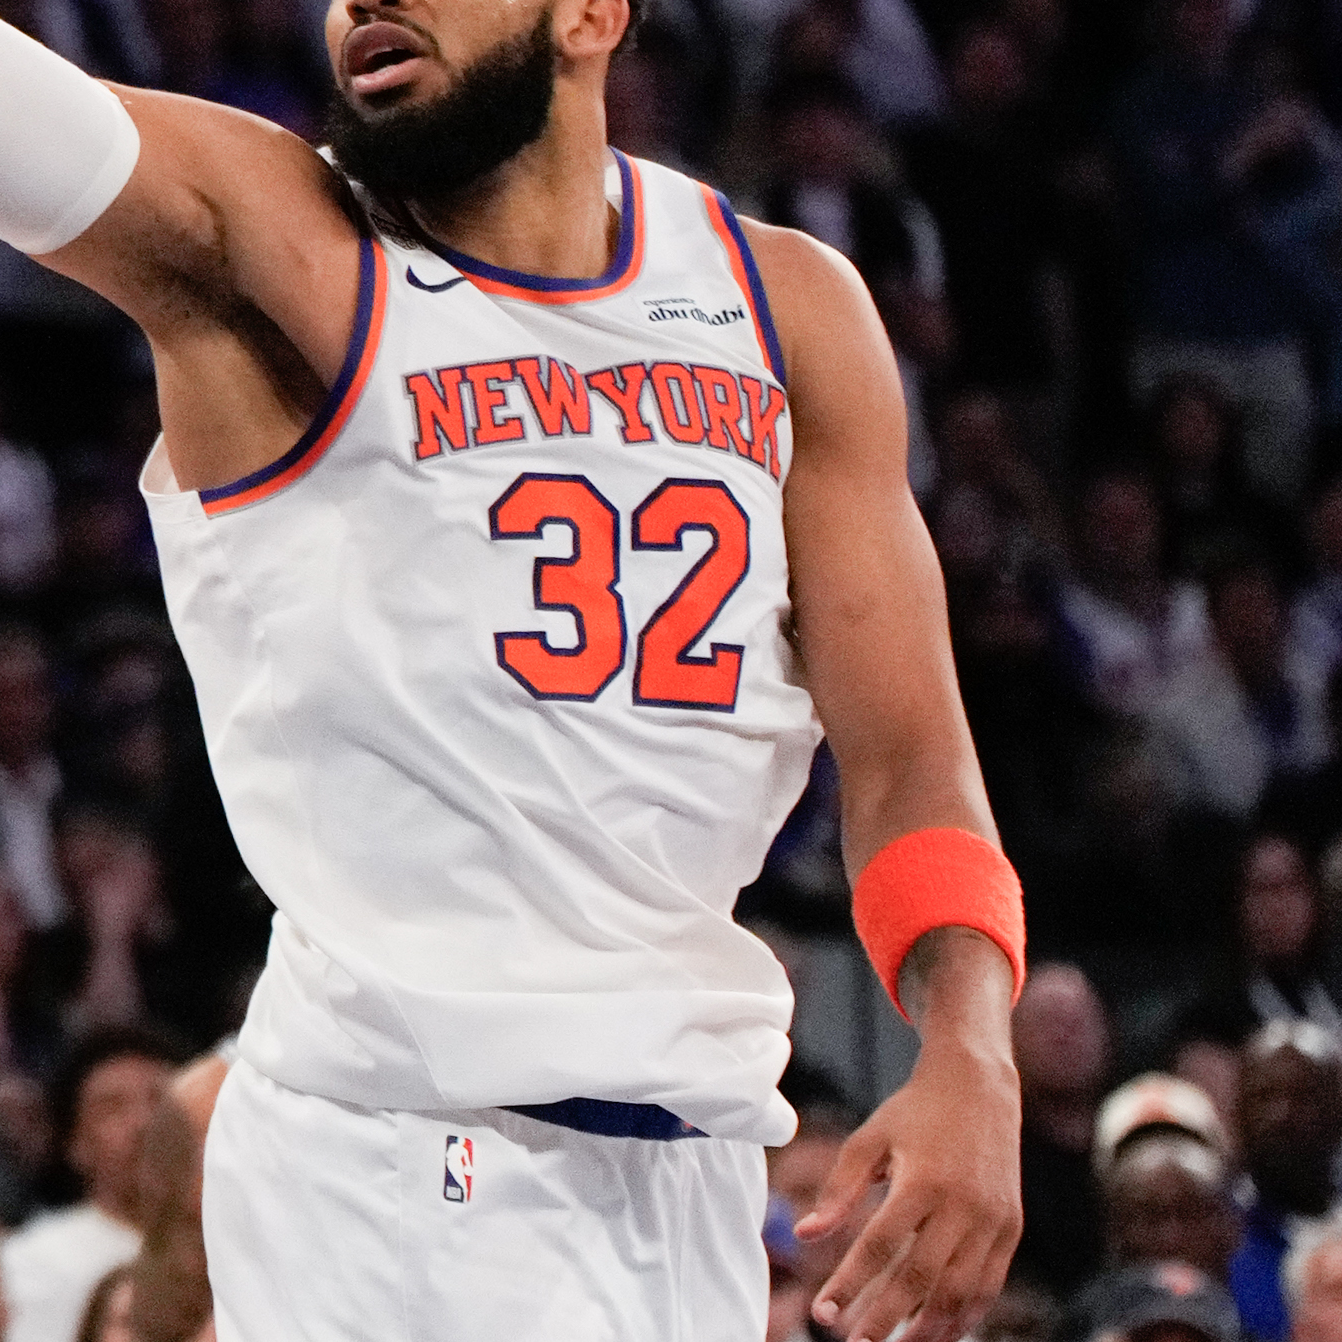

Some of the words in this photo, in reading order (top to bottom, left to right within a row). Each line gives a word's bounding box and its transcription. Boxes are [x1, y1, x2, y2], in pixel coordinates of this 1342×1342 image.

[649, 307, 689, 322] abu
[402, 355, 595, 461] NEW
[583, 359, 790, 484] YORK
[488, 471, 751, 714] 32
